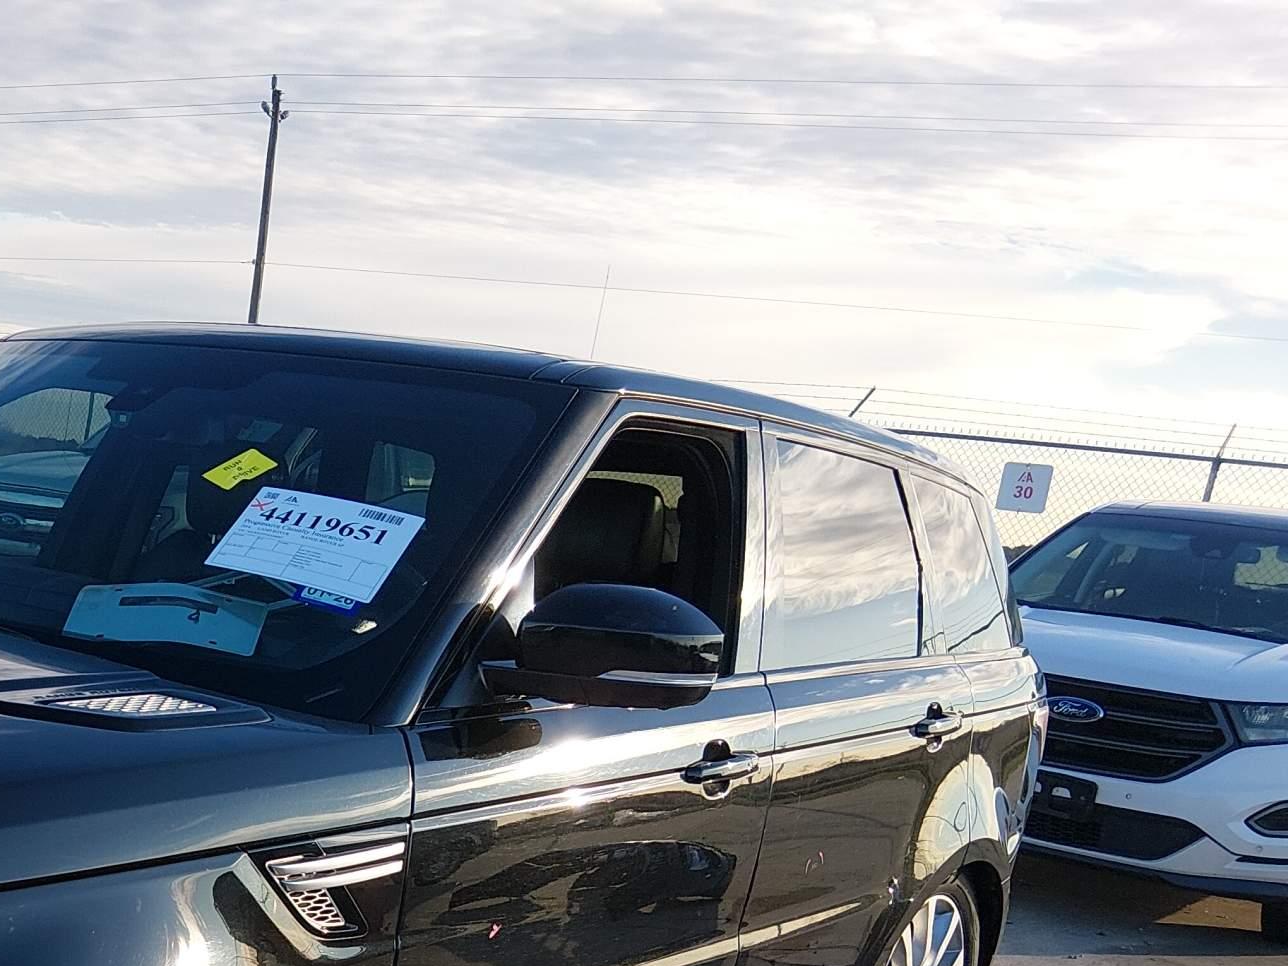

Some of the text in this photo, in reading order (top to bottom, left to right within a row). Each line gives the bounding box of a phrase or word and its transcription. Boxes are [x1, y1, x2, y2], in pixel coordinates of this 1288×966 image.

[1013, 485, 1033, 499] 30
[259, 506, 388, 546] 44119651
[1053, 700, 1089, 718] Ford
